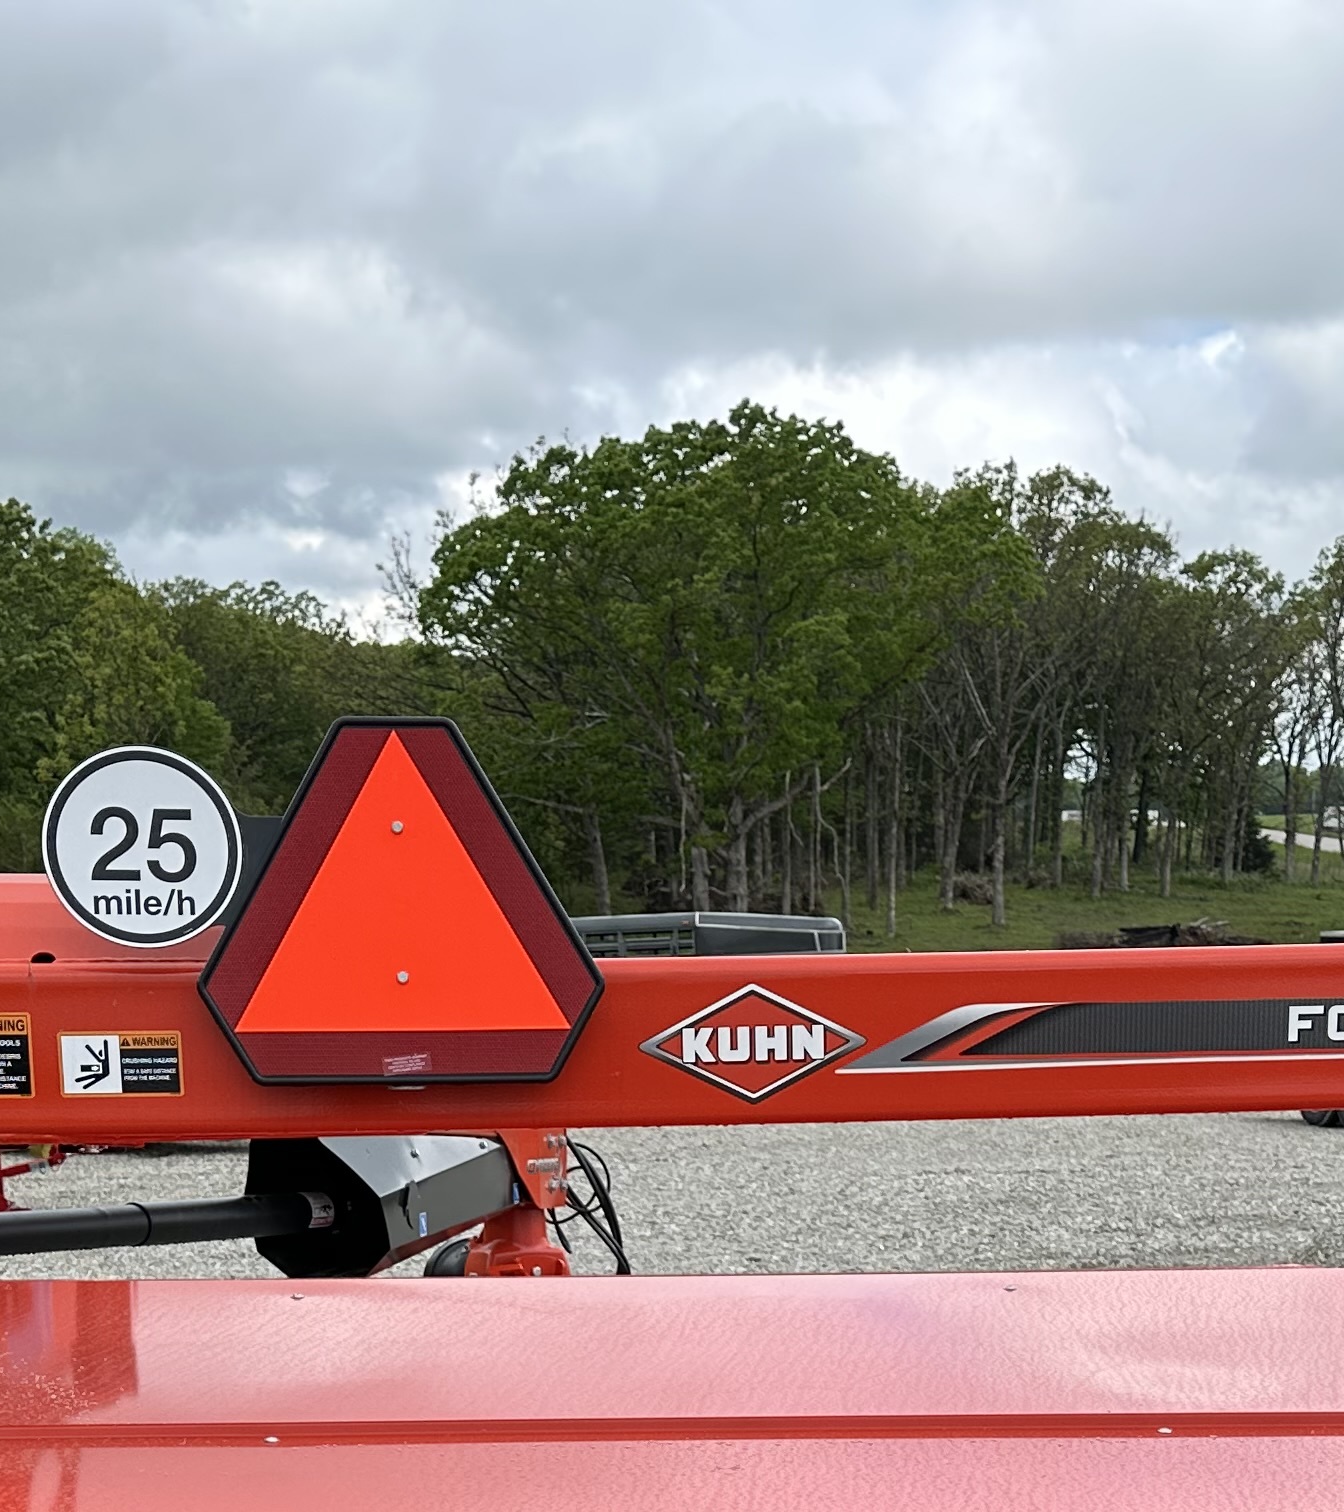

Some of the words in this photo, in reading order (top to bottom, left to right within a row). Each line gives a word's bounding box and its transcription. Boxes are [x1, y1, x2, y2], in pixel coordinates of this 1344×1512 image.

[90, 806, 197, 883] 25
[93, 888, 196, 916] mile/h
[132, 1036, 176, 1047] WARNING
[682, 1024, 825, 1064] KUHN
